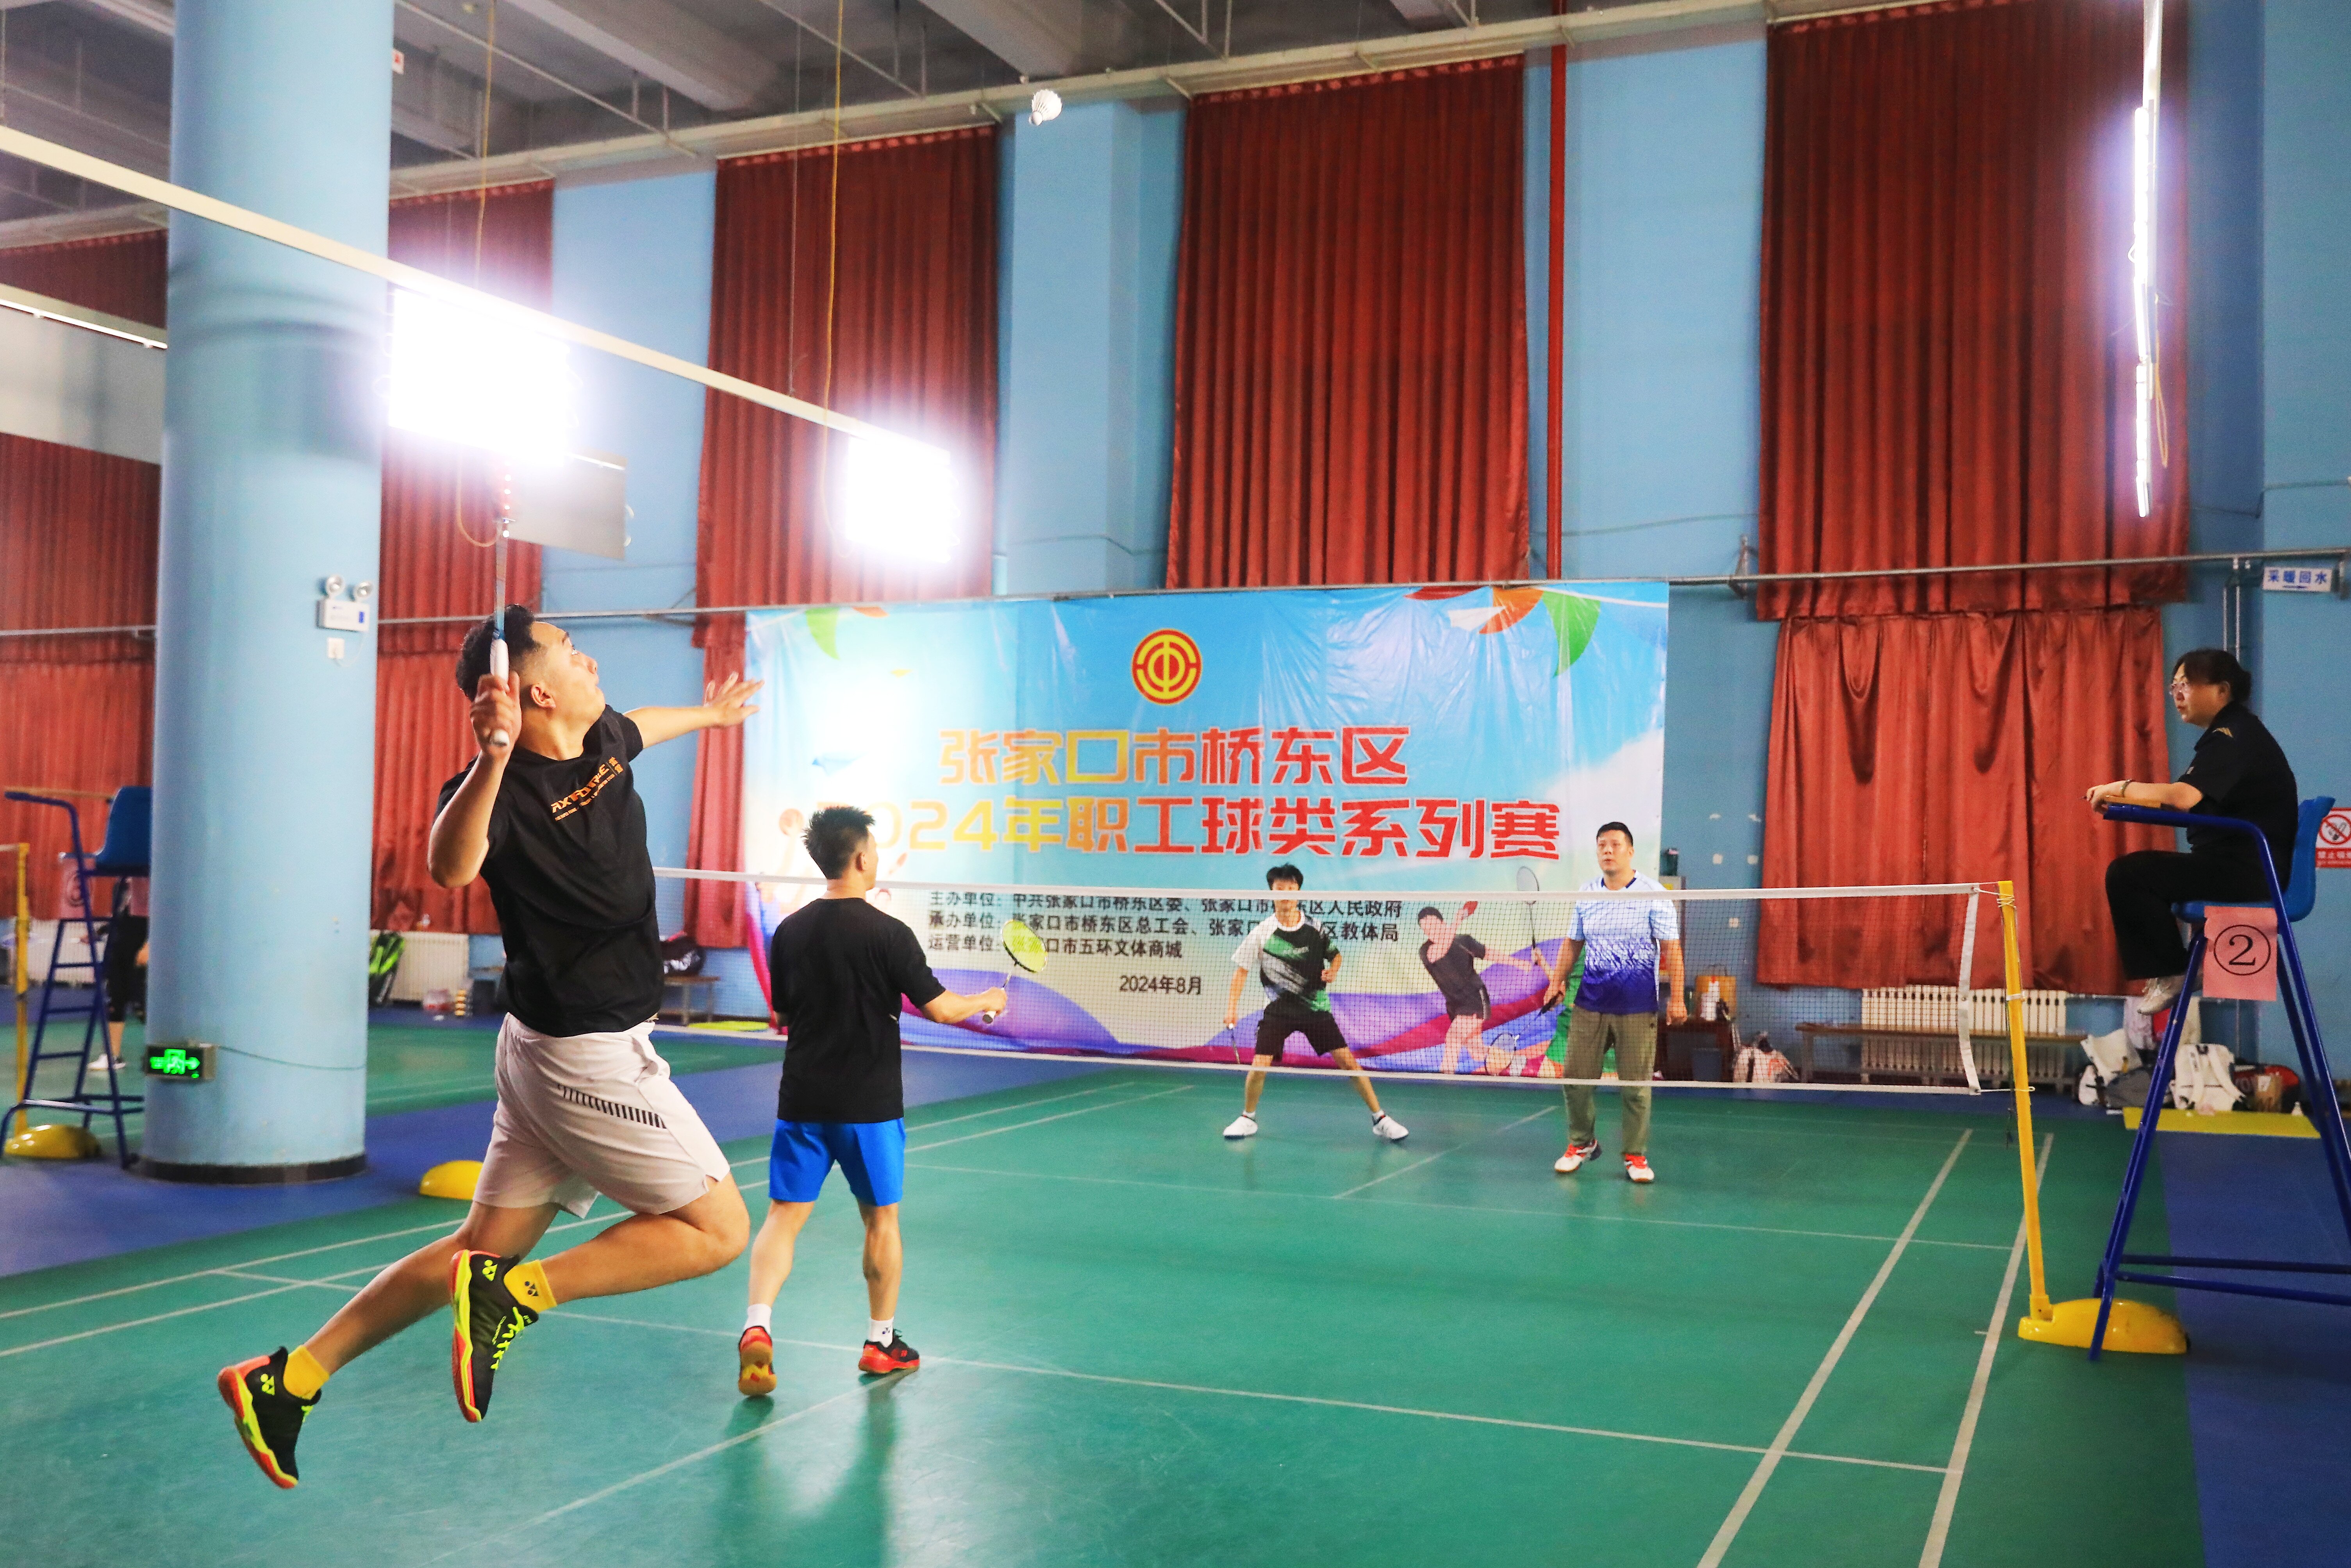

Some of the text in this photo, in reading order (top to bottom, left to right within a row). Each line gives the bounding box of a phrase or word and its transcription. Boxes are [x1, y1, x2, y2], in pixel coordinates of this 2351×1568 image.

[939, 727, 1410, 785] 张家口市桥东区
[817, 797, 1559, 859] 024年职工球类系列赛
[1119, 975, 1201, 995] 2024年8月
